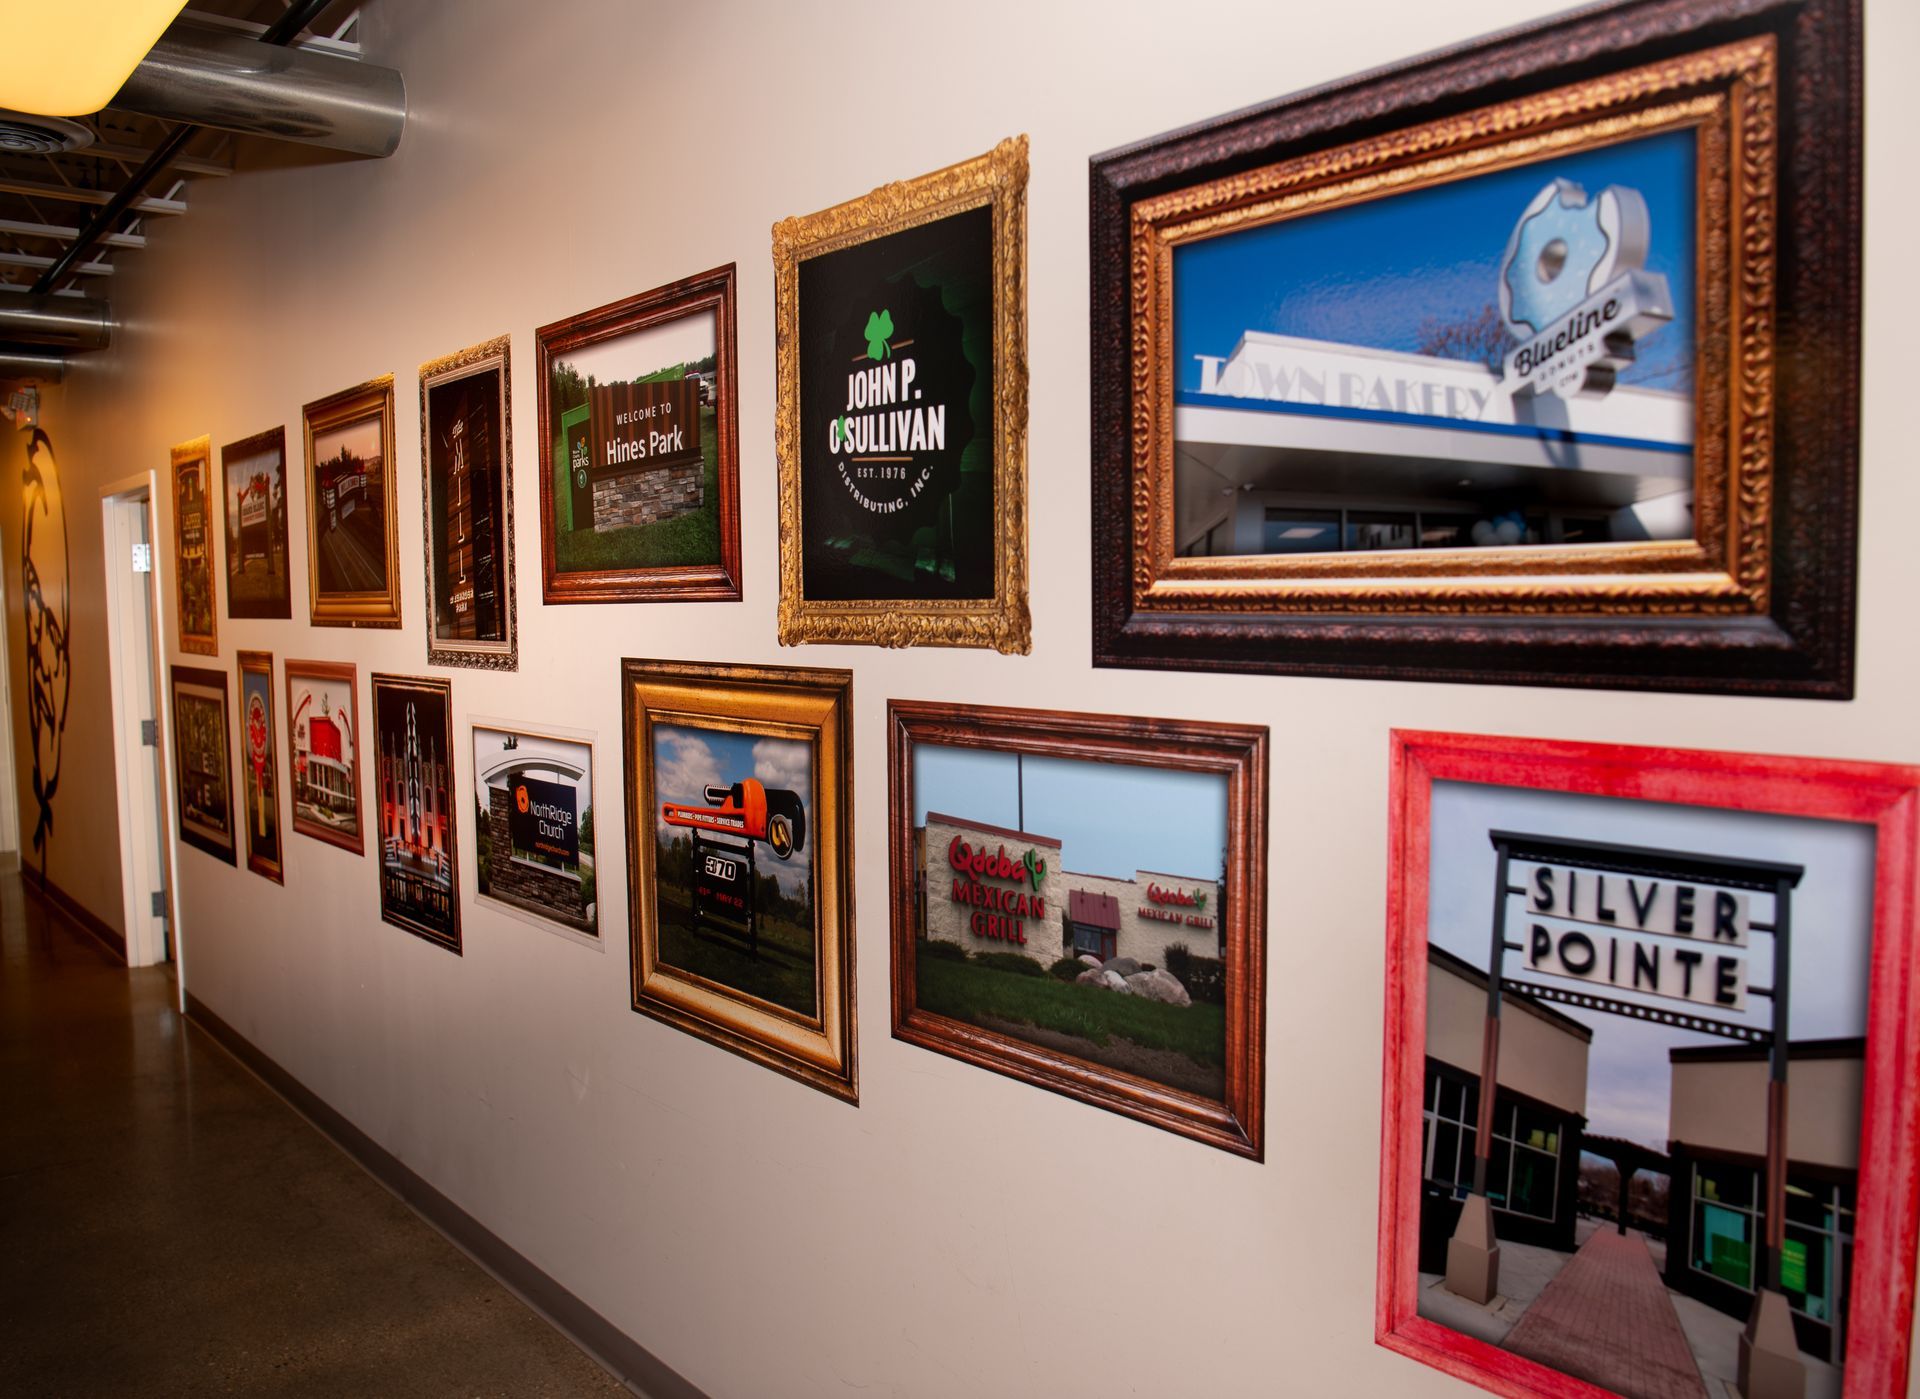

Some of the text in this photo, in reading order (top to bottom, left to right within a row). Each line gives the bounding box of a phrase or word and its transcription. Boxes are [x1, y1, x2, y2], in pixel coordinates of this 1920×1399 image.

[1514, 299, 1622, 377] Blueline
[847, 358, 922, 411] JOHN P.
[1337, 372, 1492, 421] BAKERY
[616, 402, 672, 425] WELCOME TO
[572, 450, 590, 472] parks
[606, 424, 683, 465] Hines Park
[857, 467, 906, 480] EST. 1976
[530, 800, 572, 826] NorthRidge
[539, 820, 565, 840] Church
[705, 856, 736, 881] 370
[948, 834, 1026, 883] Qdoba
[952, 878, 1045, 920] MEXICAN
[1147, 881, 1195, 907] Qdoba
[1533, 866, 1738, 941] SILVER
[970, 910, 1028, 944] GRILL
[1137, 905, 1214, 930] MEXICAN GRILL
[1530, 924, 1738, 1005] POINTE
